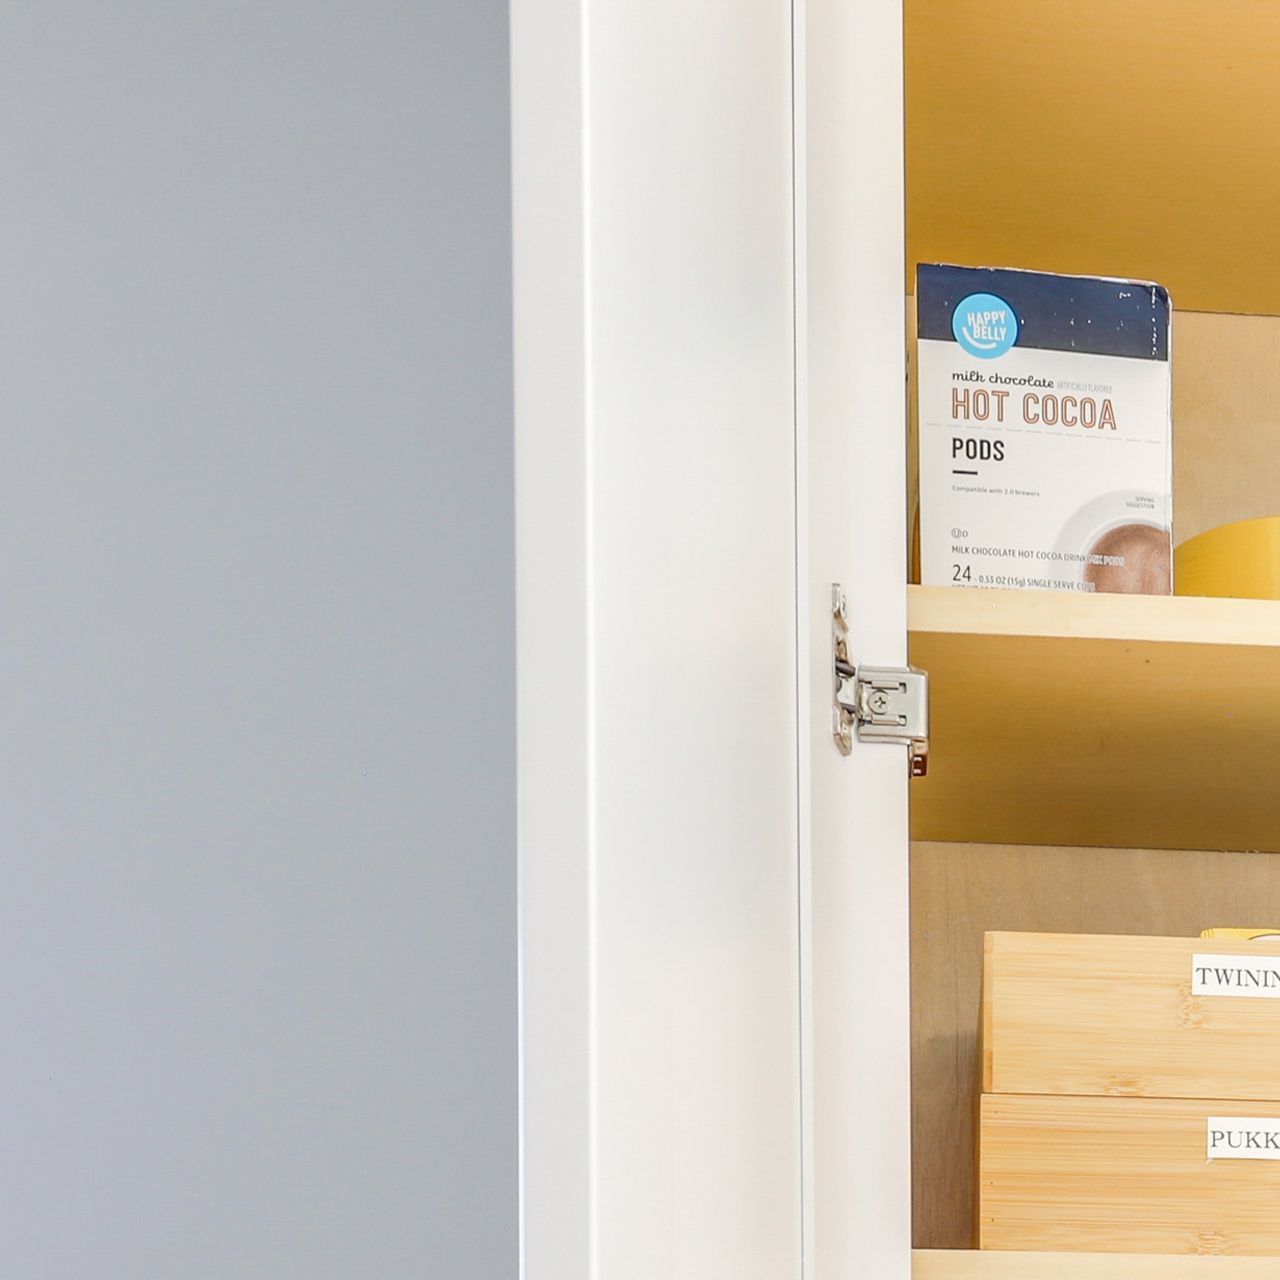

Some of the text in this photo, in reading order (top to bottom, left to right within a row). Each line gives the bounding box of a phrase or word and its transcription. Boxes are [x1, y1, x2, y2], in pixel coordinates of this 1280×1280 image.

[967, 311, 1006, 327] HAPPY
[973, 326, 1007, 342] BELLY
[952, 371, 985, 382] milk
[989, 373, 1054, 388] chocolate
[952, 388, 1116, 430] HOT COCOA
[952, 437, 1005, 461] PODS
[952, 546, 969, 554] MILK
[972, 547, 1015, 558] CHOCOLATE
[1018, 550, 1034, 559] HOT
[1036, 551, 1062, 561] COCOA
[952, 564, 972, 581] 24
[1027, 579, 1050, 588] SINGLE
[1054, 581, 1074, 590] SERVE
